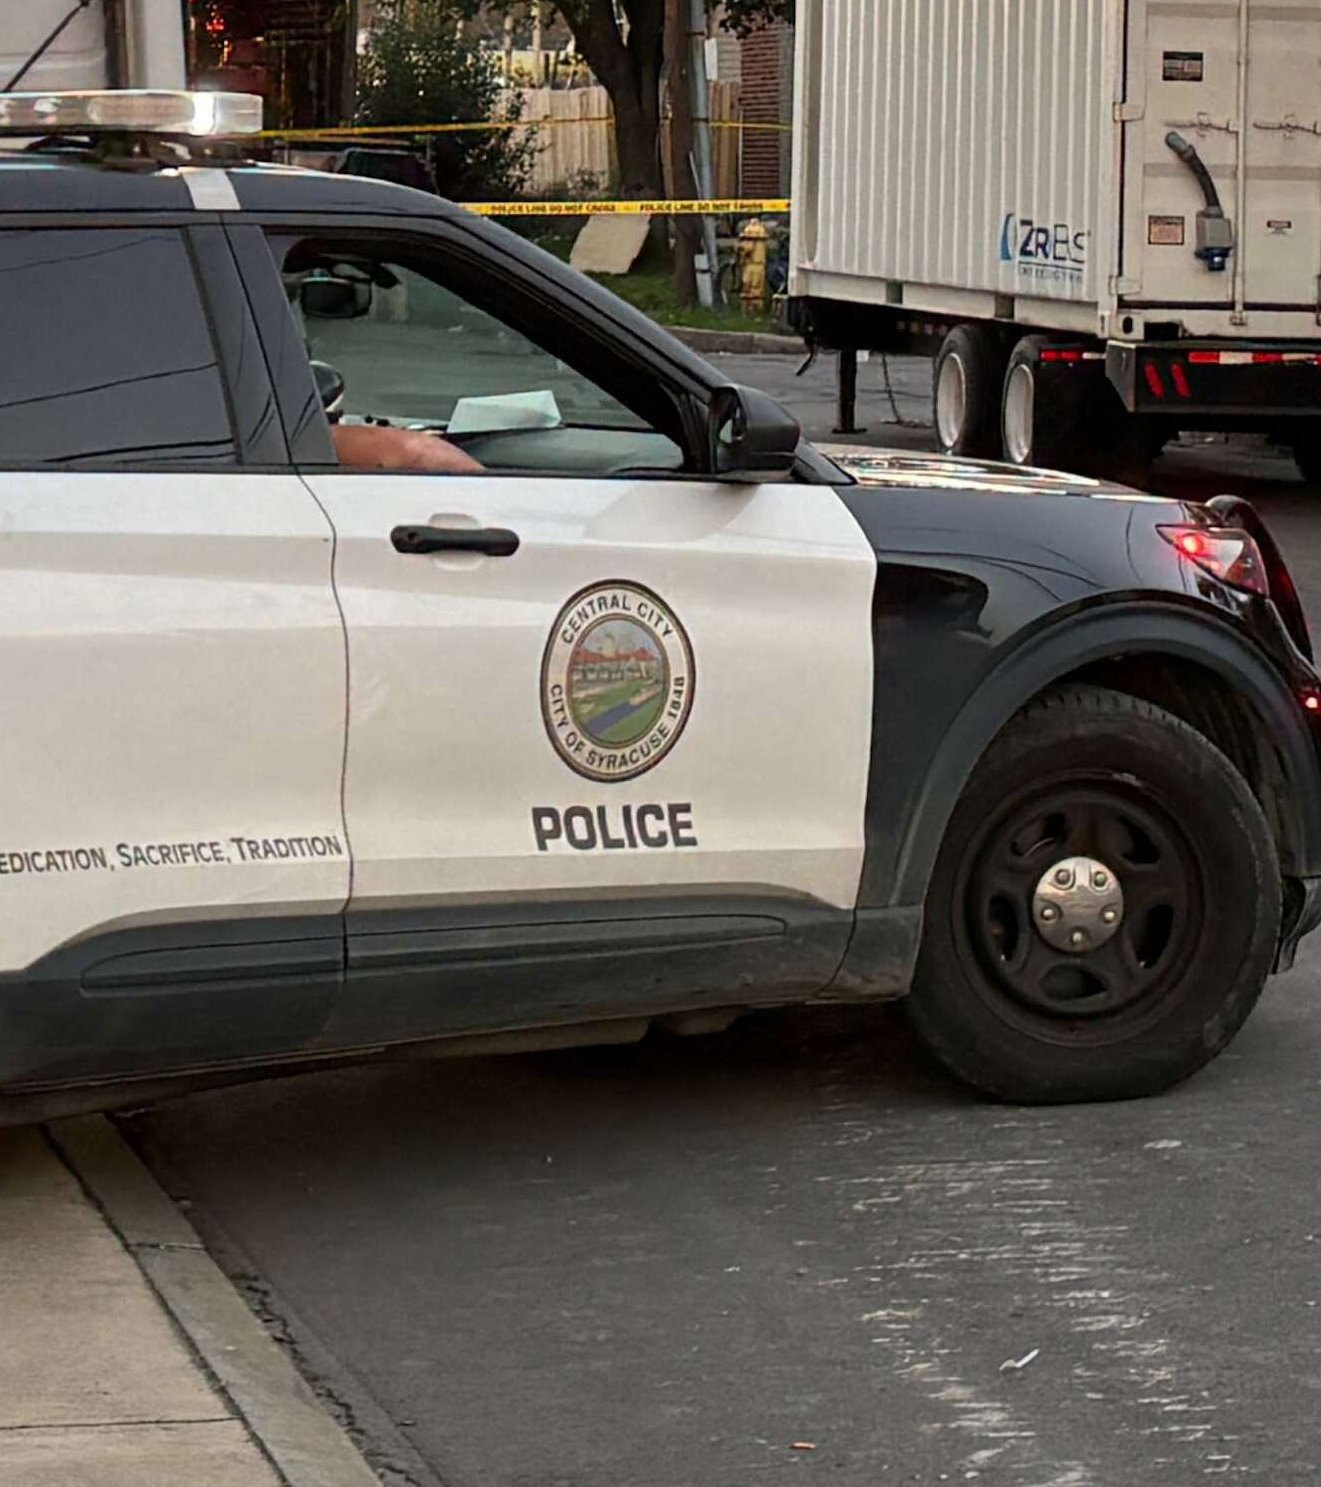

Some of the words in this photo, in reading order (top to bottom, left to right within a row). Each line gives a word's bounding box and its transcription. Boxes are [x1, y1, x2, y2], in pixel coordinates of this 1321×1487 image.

[561, 593, 631, 645] CENTRAL
[637, 601, 674, 638] CITY
[549, 683, 569, 730] CITY
[564, 730, 584, 756] OF
[585, 724, 670, 771] SYRACUSE
[531, 802, 698, 851] POLICE
